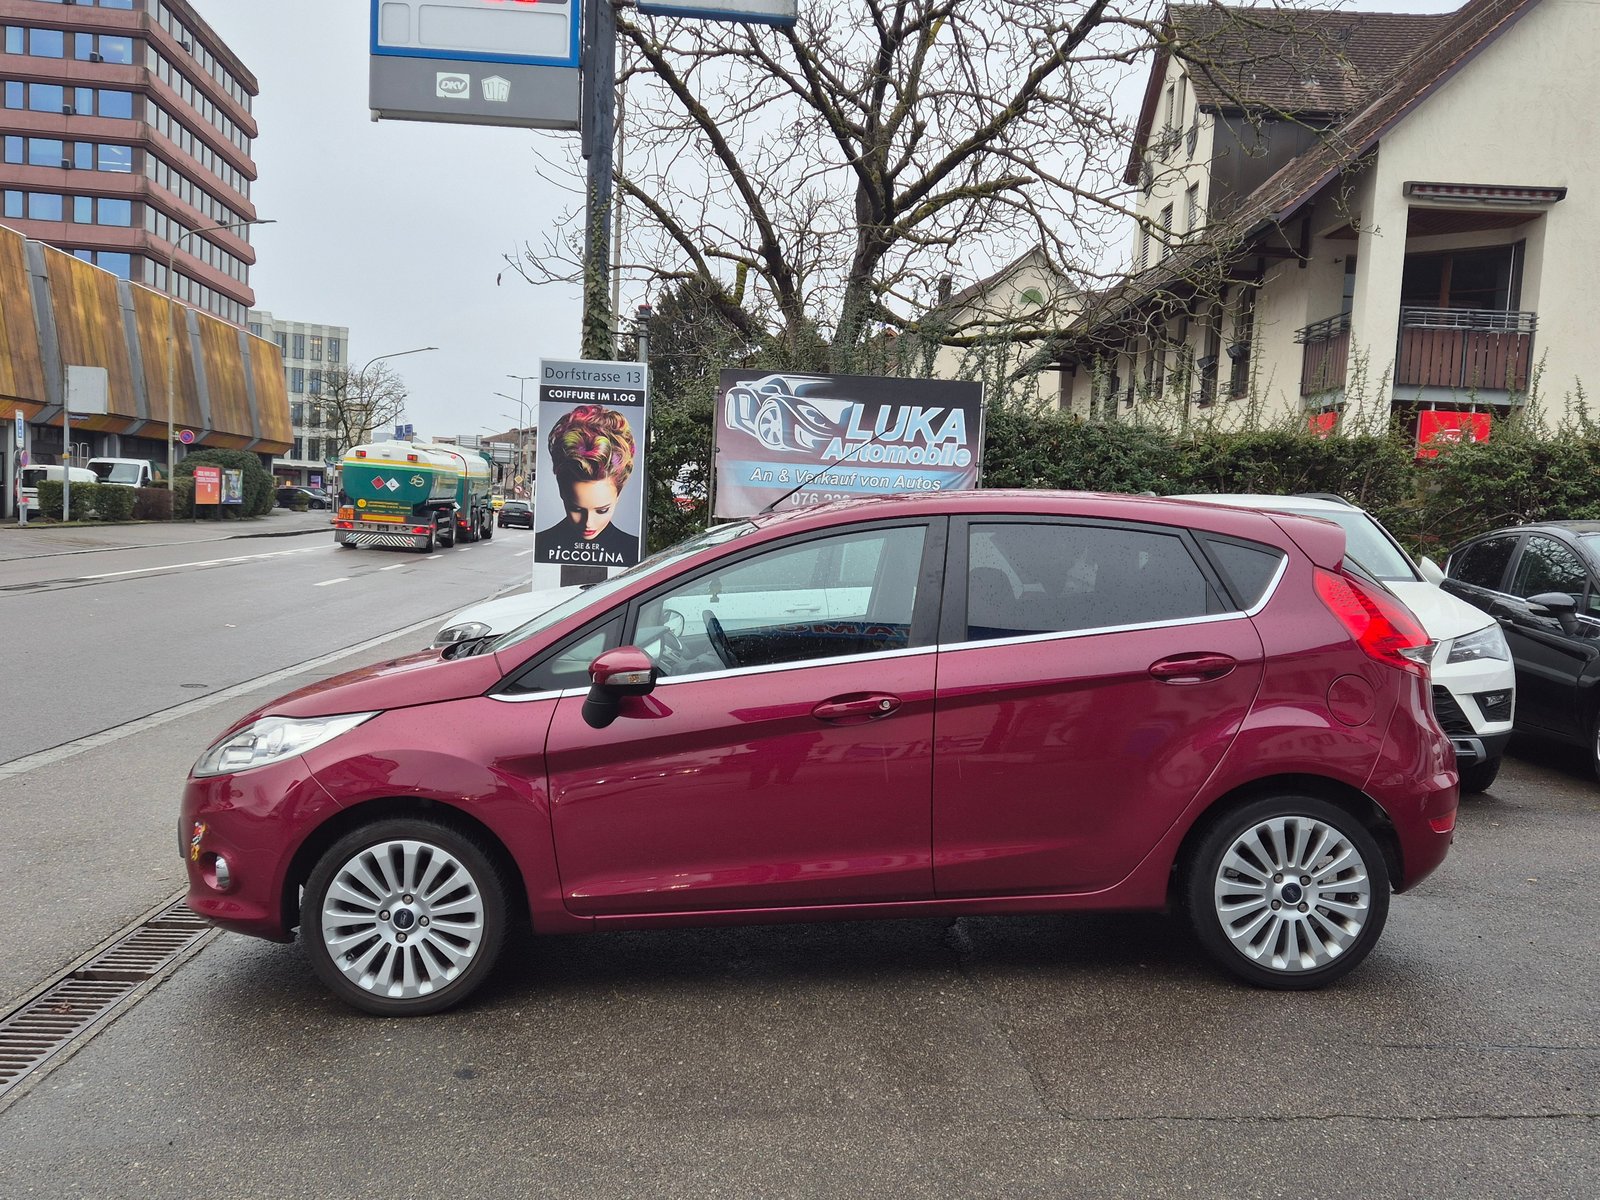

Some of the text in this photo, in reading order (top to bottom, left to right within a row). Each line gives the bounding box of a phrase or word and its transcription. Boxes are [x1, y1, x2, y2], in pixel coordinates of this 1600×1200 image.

[441, 80, 465, 90] DKV
[484, 77, 509, 101] UTA
[545, 367, 641, 383] Dorfstrasse 13
[548, 389, 636, 402] COIFFURE IM 1.OG
[845, 403, 968, 445] LUKA
[821, 438, 972, 467] Automobile
[750, 467, 942, 491] An & Verkauf von Autos
[791, 492, 819, 505] 076
[574, 542, 584, 550] SIE
